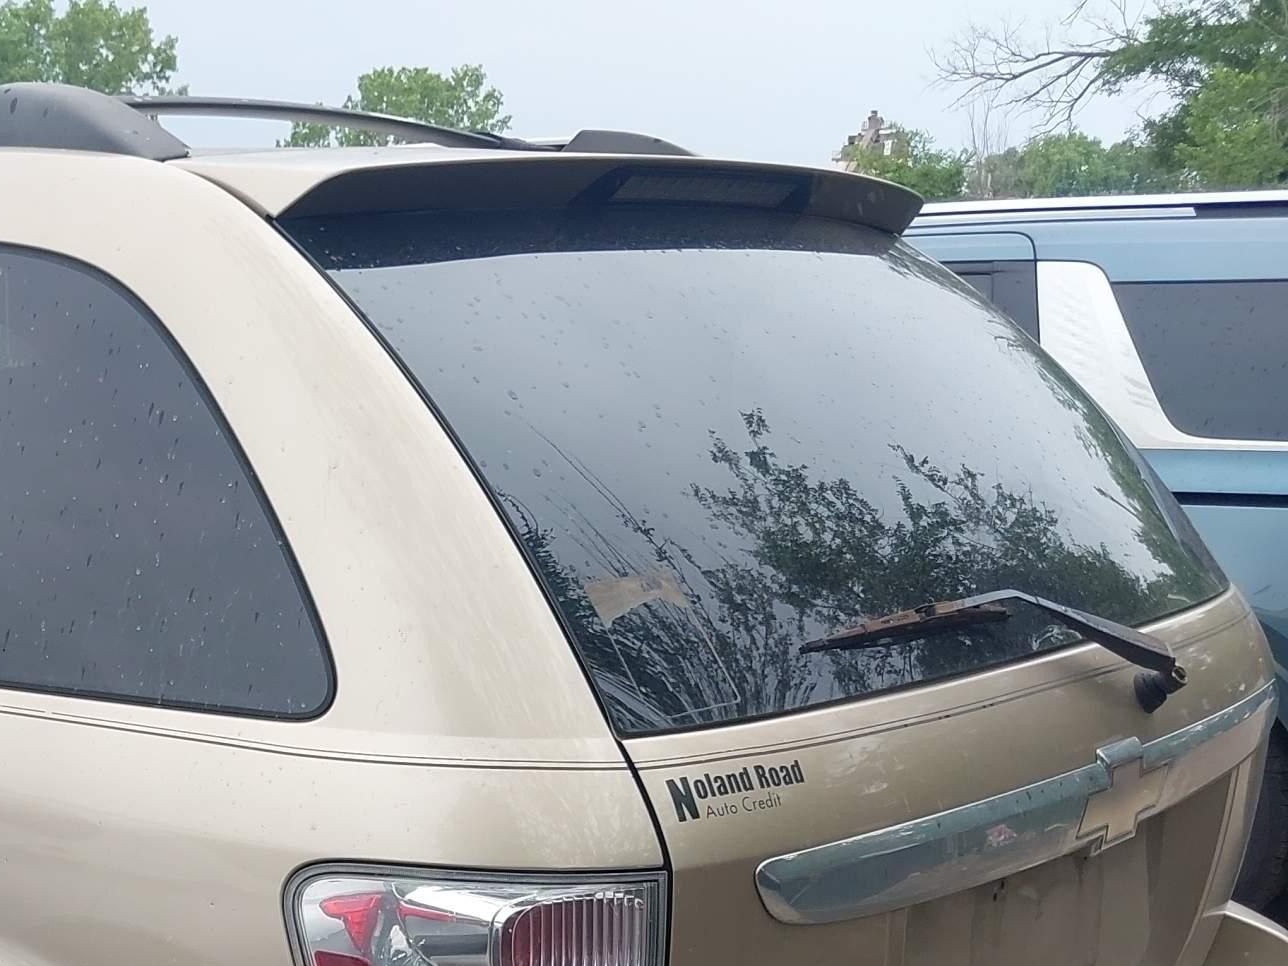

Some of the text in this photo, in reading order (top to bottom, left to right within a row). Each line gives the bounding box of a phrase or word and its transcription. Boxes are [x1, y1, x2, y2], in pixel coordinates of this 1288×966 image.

[665, 759, 805, 823] Noland Road
[706, 792, 782, 819] Auto Credit
